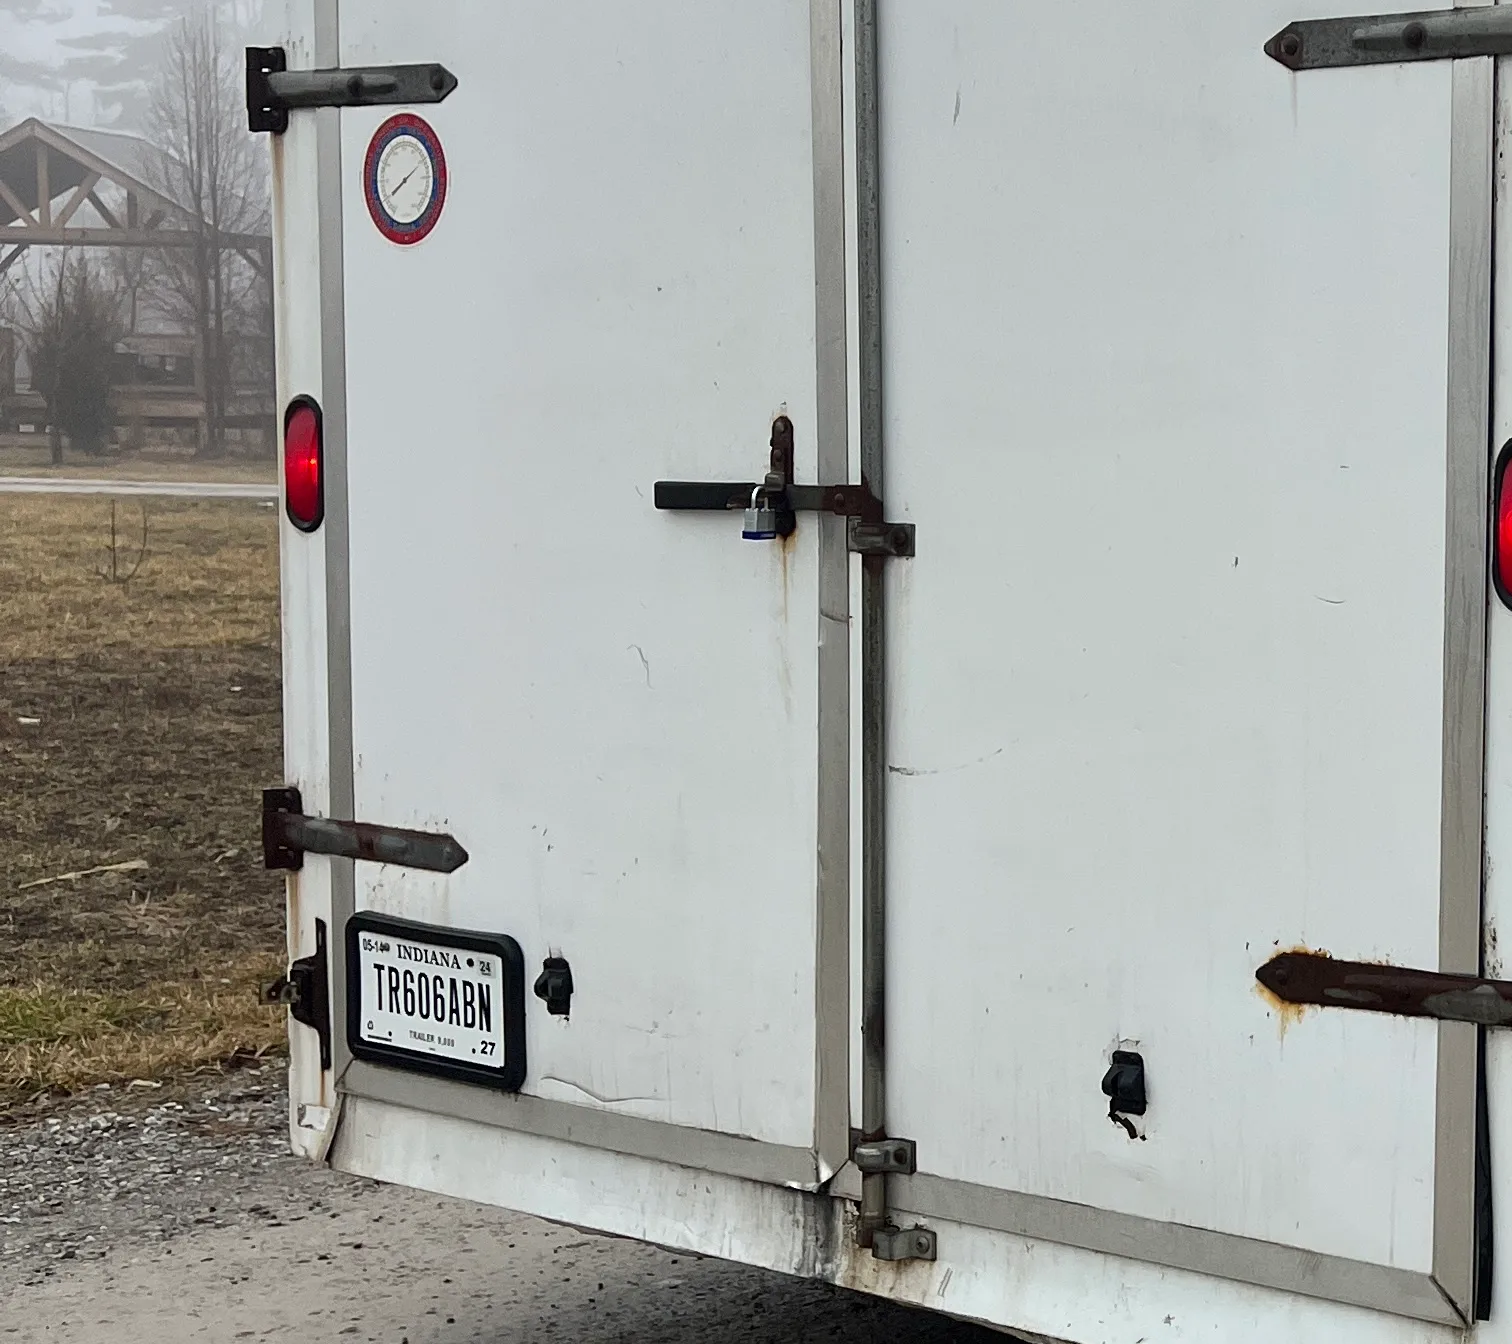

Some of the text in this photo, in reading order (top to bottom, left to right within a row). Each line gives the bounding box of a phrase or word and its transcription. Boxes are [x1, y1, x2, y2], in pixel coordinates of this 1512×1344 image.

[397, 944, 461, 969] INDIANA
[373, 963, 491, 1032] TR606ABN
[481, 1041, 495, 1055] 27
